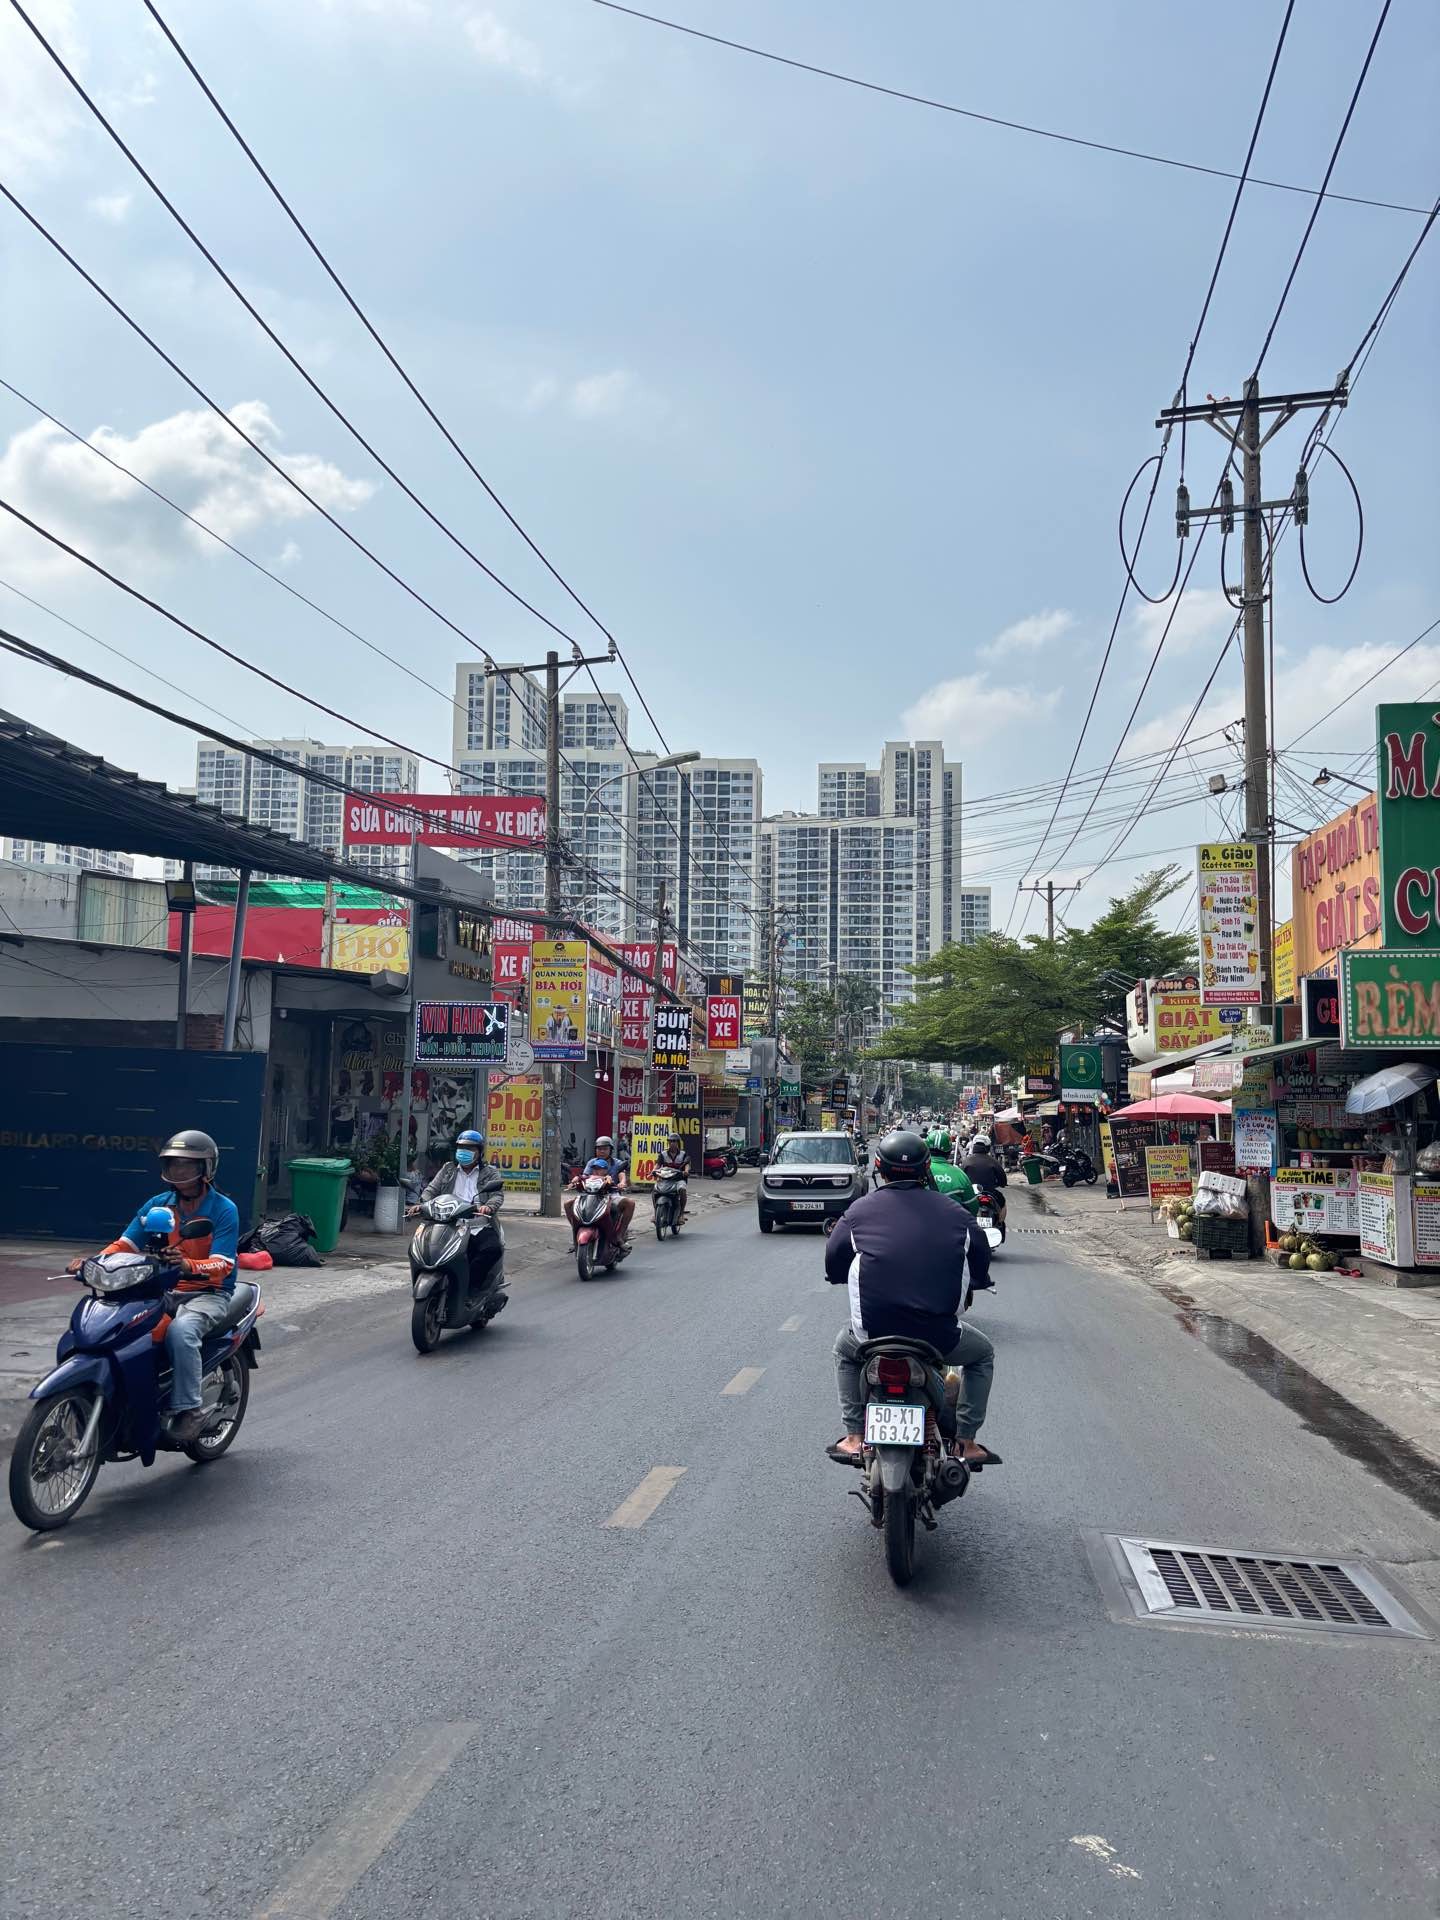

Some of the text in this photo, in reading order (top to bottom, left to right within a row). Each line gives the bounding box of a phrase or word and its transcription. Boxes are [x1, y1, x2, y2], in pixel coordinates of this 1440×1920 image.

[351, 801, 380, 833] SỬA
[428, 809, 447, 835] XE
[451, 805, 482, 836] MÁY
[495, 810, 514, 836] XE
[1221, 845, 1253, 860] Giàu
[1297, 838, 1327, 895] TẠP
[1316, 881, 1360, 955] GIẶT
[336, 928, 400, 960] PHỞ
[500, 955, 517, 977] XE
[535, 979, 582, 990] BIA HƠI
[623, 1000, 639, 1018] XE
[711, 998, 737, 1019] SỬA
[1170, 996, 1190, 1005] Kim
[422, 1006, 485, 1036] WIN HAIR
[657, 1009, 690, 1029] BÚN
[1158, 1008, 1213, 1030] GIẶT
[623, 1023, 639, 1040] XE
[715, 1021, 732, 1037] XE
[656, 1030, 688, 1051] CHẢ
[488, 1089, 542, 1121] Phở
[634, 1119, 651, 1136] BÚN
[653, 1119, 670, 1137] CHẢ
[1117, 1127, 1128, 1136] ZIN
[637, 1138, 648, 1154] HÀ
[490, 1149, 513, 1169] ẨU
[933, 1174, 952, 1184] rab
[1276, 1176, 1304, 1184] COFFEE
[875, 1407, 914, 1425] 50-X1
[869, 1425, 921, 1443] 163.42
